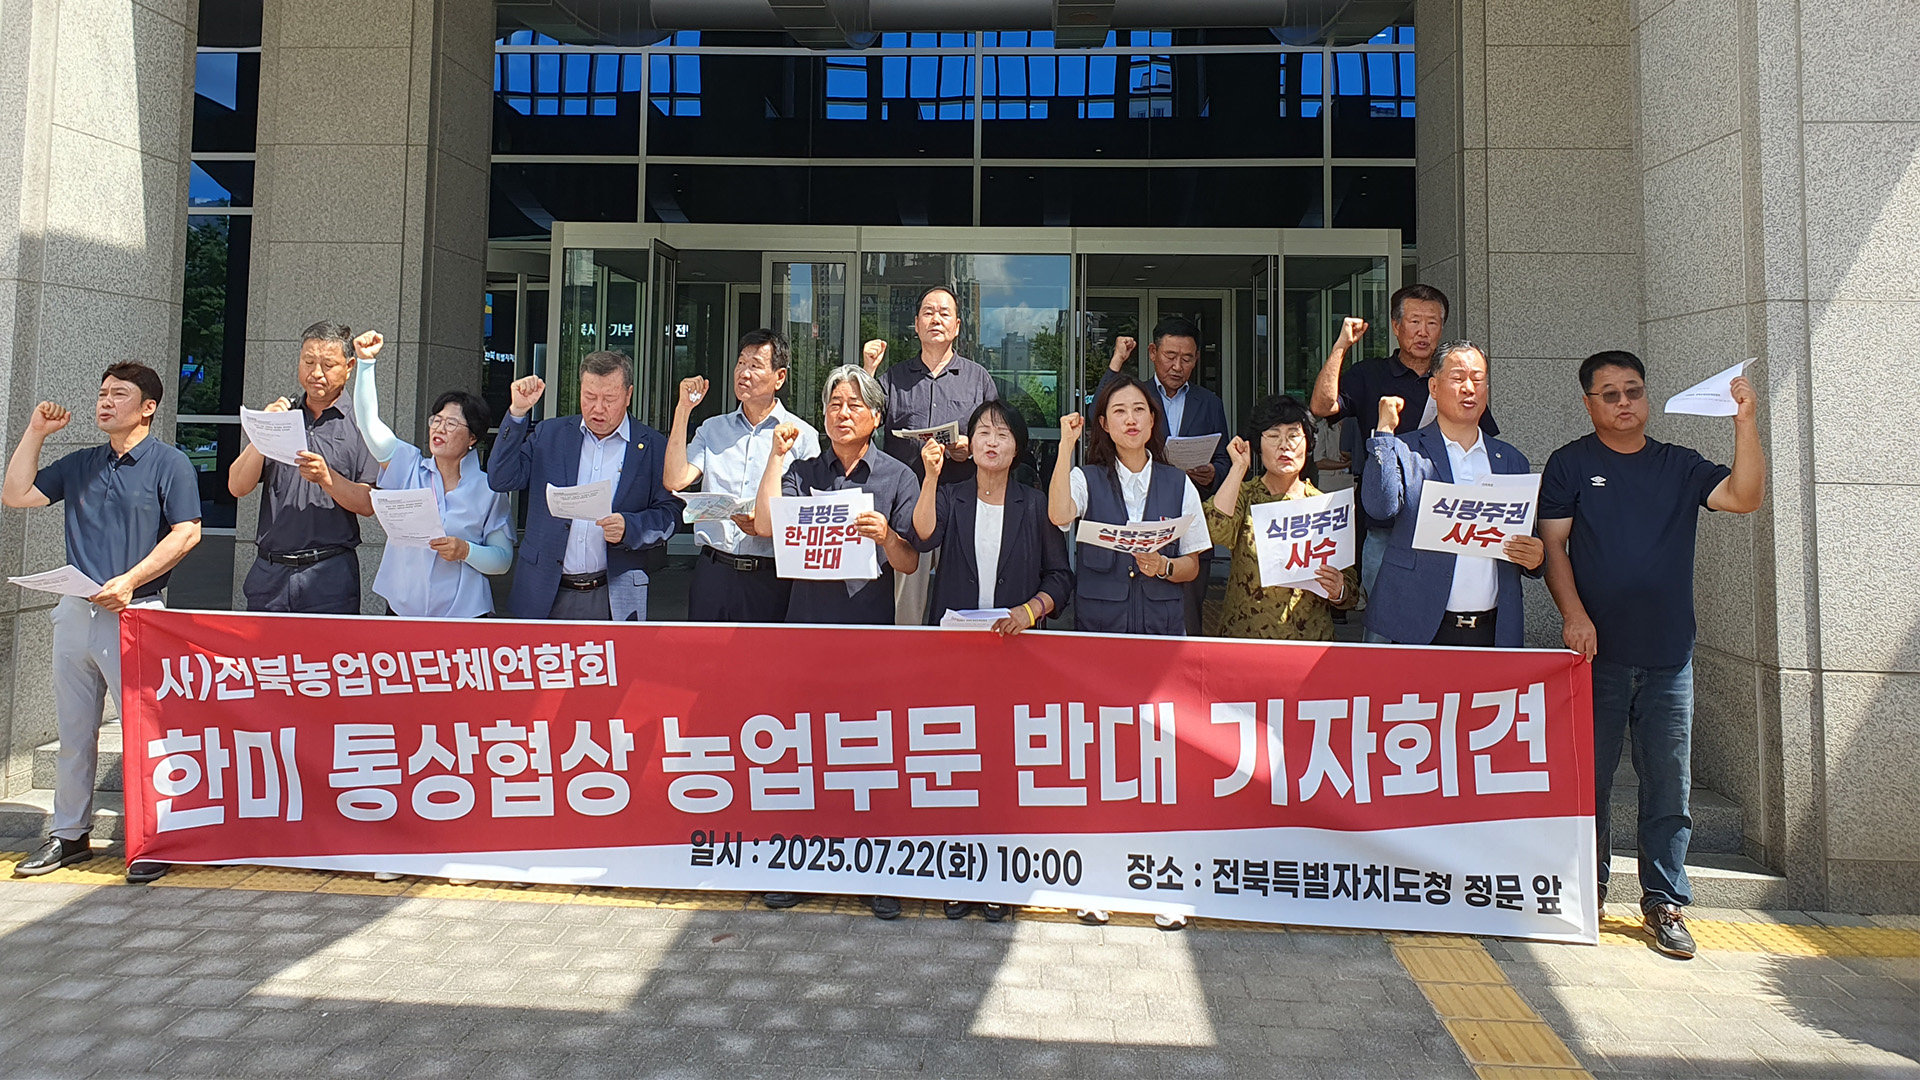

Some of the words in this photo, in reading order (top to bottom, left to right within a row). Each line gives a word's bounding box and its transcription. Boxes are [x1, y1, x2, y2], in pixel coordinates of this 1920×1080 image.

[798, 504, 849, 524] 불평등
[1266, 504, 1349, 540] 식량주권
[1432, 497, 1530, 525] 식량주권
[1441, 522, 1506, 548] 사수
[804, 548, 842, 569] 반대
[1285, 537, 1337, 571] 사수
[155, 640, 618, 701] 사)전북농업인단체연합회
[148, 725, 303, 833] 한미
[328, 718, 635, 821] 통상협상
[662, 705, 982, 813] 농업부문
[1013, 702, 1177, 807] 반대
[1210, 682, 1550, 806] 기자회견
[690, 829, 742, 868] 일시
[767, 832, 988, 882] 2025.07.22(화)
[997, 845, 1083, 886] 10:00
[1126, 852, 1184, 891] 장소
[1212, 857, 1453, 905] 전북특별자치도청
[1464, 874, 1524, 910] 정문
[1533, 874, 1562, 915] 앞
